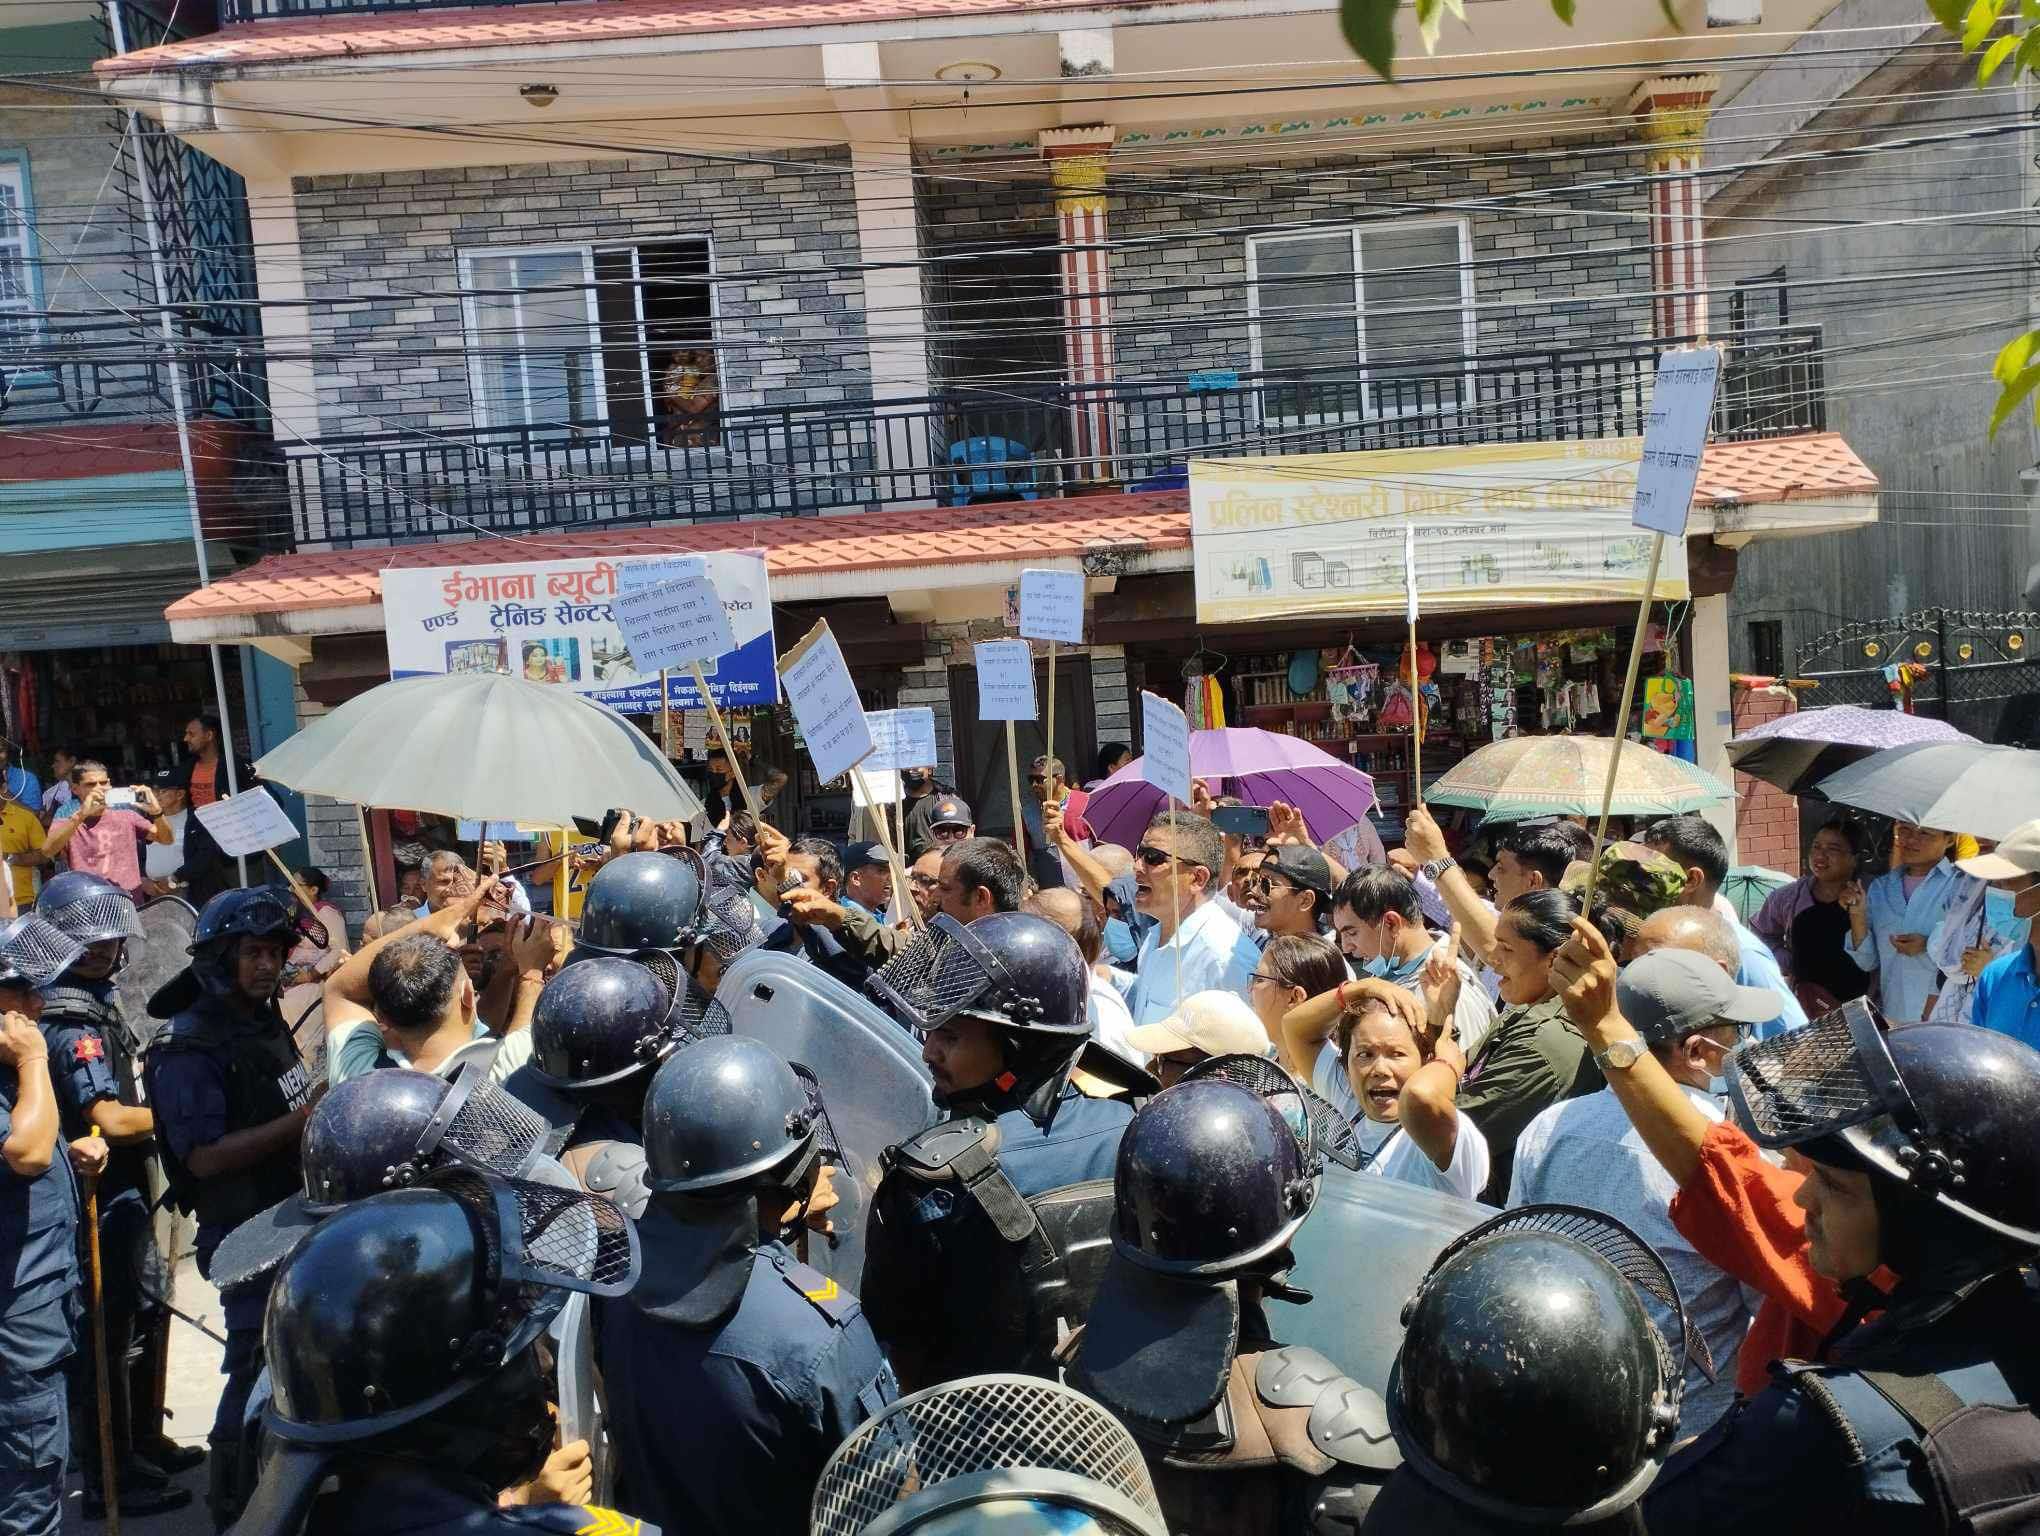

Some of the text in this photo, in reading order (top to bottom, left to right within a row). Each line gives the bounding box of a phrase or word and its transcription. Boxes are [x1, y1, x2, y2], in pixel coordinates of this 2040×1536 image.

[442, 561, 617, 607] ईभाना ब्यूटी
[421, 610, 459, 632] एण्ड
[555, 600, 615, 626] सेन्टर
